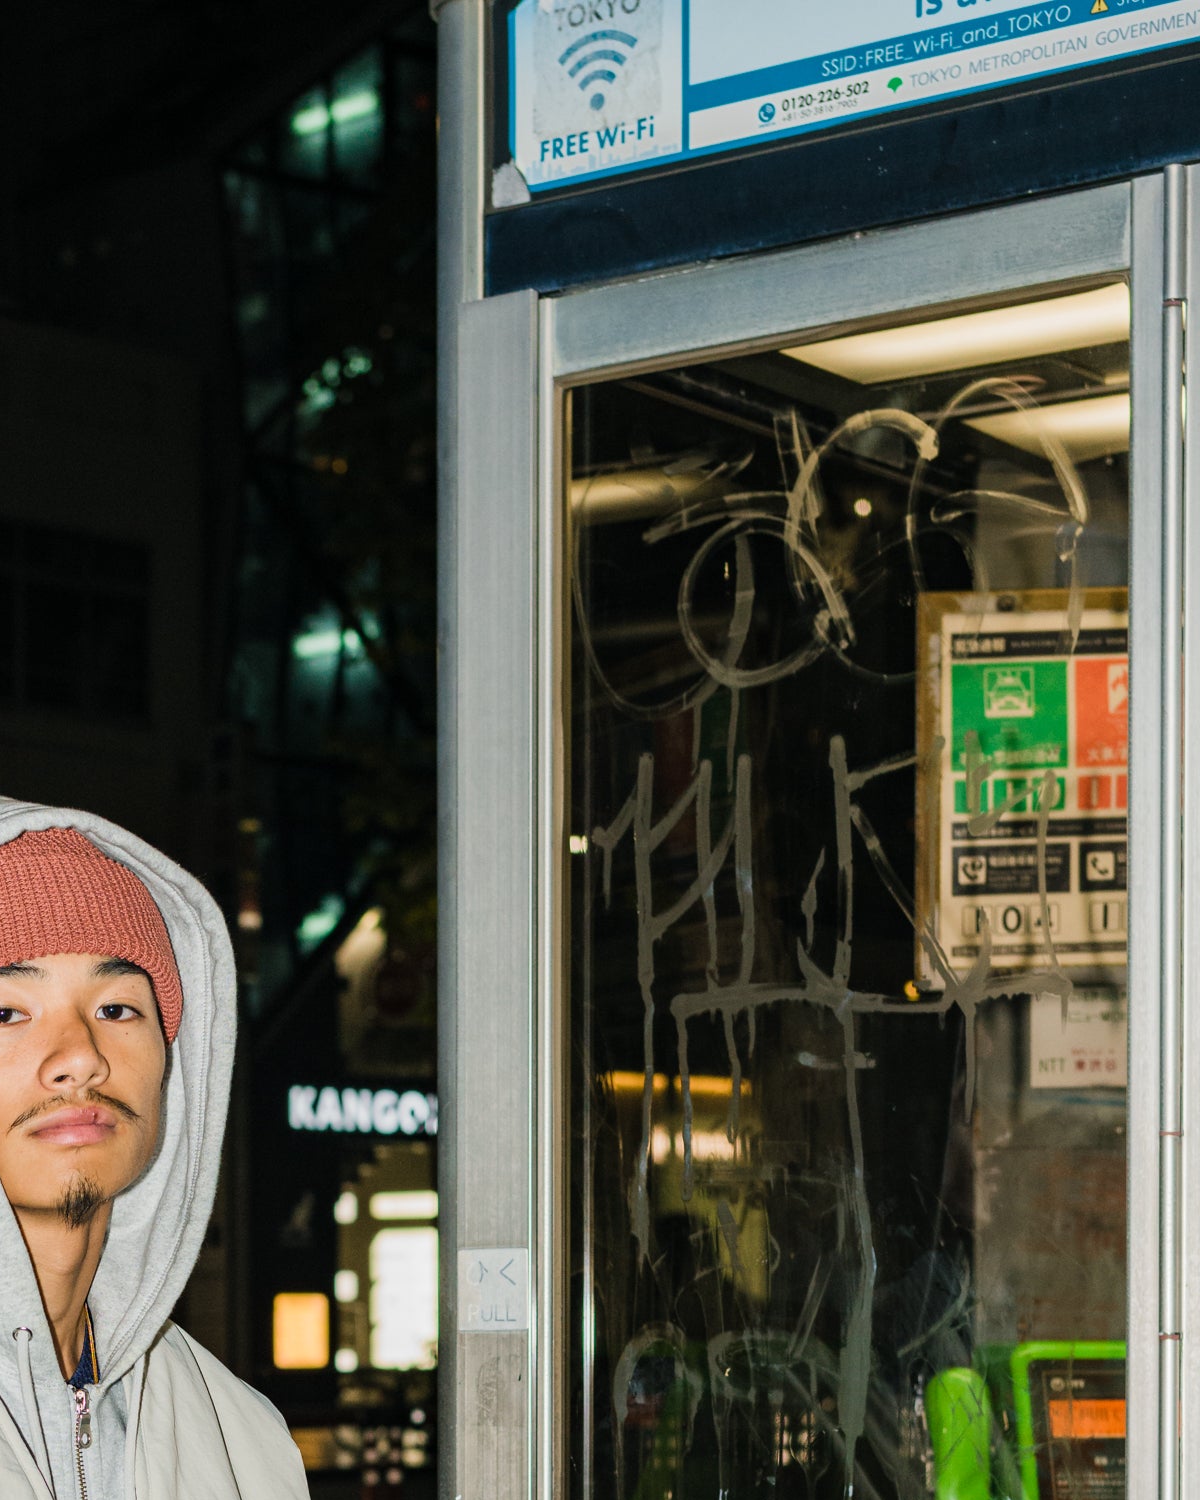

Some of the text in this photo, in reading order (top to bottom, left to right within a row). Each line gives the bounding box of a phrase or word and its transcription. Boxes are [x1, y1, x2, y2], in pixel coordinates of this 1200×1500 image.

[554, 0, 640, 31] TOKYO
[910, 10, 1200, 88] TOKYO METROPOLITAN GOVERNMEN
[782, 81, 870, 112] 0120-226-502
[540, 115, 654, 162] FREE Wi-Fi
